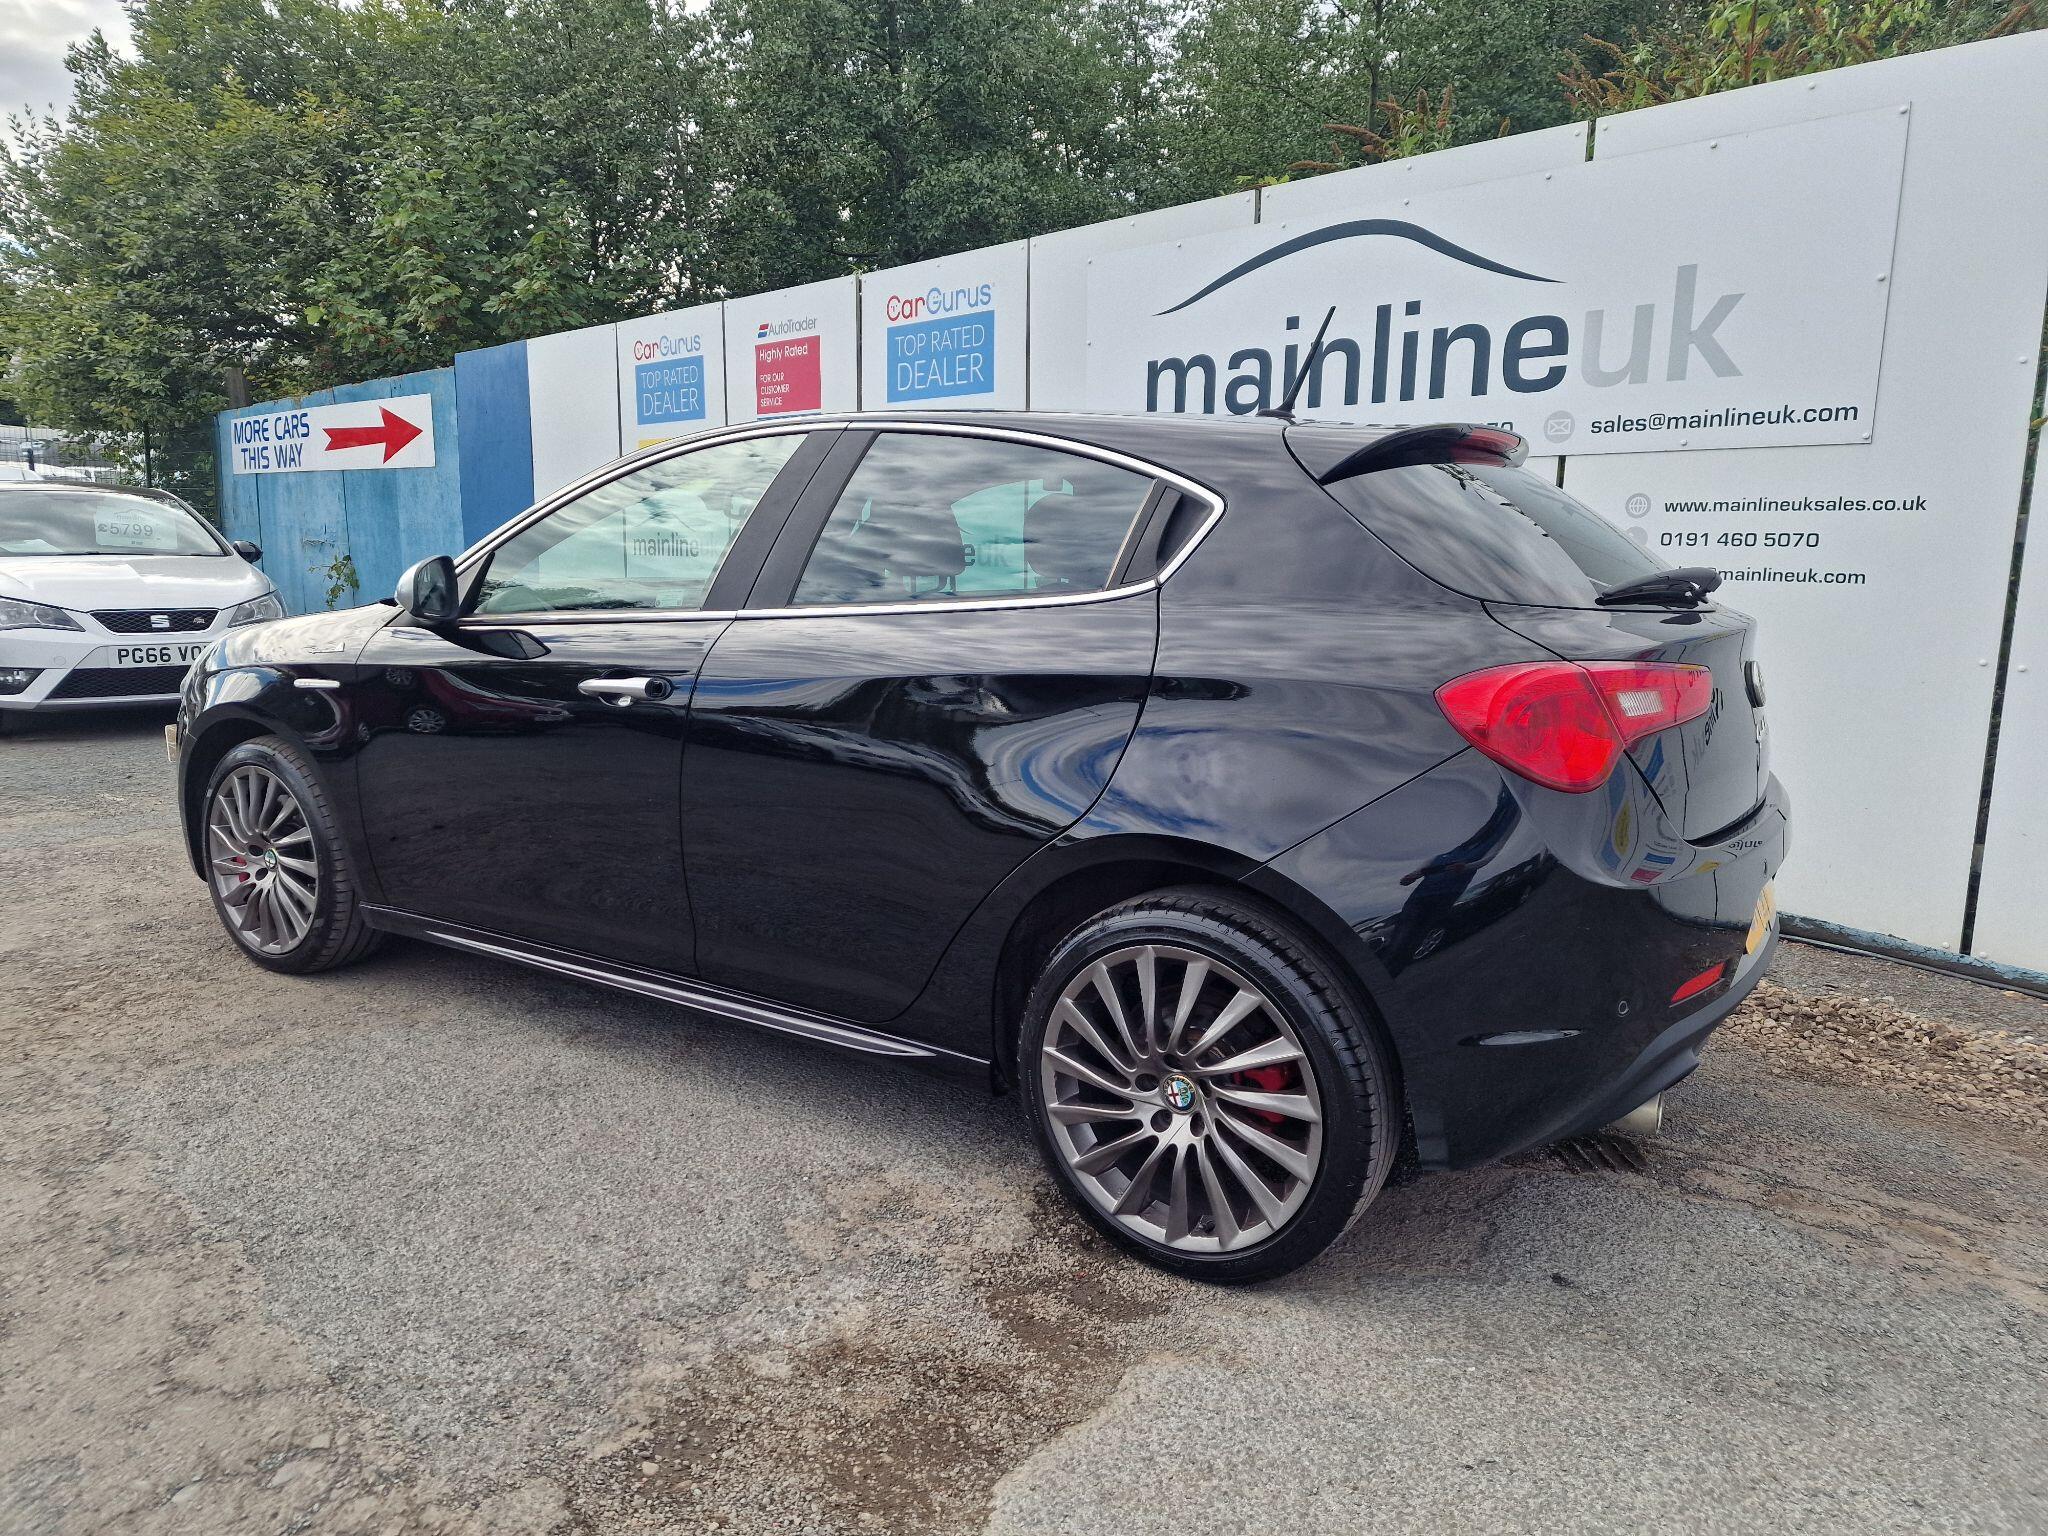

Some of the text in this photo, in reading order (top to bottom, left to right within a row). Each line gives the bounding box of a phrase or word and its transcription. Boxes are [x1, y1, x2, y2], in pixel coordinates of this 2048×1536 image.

[887, 284, 991, 321] CarGurus
[634, 335, 701, 360] CarGurus
[895, 325, 985, 356] TOP RATED
[1147, 264, 1745, 415] mainlineuk
[760, 343, 808, 362] Highly Rated
[641, 366, 698, 388] TOP RATED
[760, 372, 784, 383] FOR OUR
[898, 353, 984, 391] DEALER
[761, 384, 789, 395] CUSTOMER
[643, 388, 699, 415] DEALER
[760, 397, 782, 407] SERVICE
[234, 413, 310, 444] MORE CARS
[1591, 405, 1858, 434] sales@mainlineuk.com
[241, 443, 303, 470] THIS WAY
[1664, 496, 1927, 513] www.mainlineuksales.co.uk
[97, 522, 153, 537] £5799
[1660, 532, 1820, 548] 0191 460 5070
[1710, 567, 1866, 585] mainlineuk.com
[117, 645, 206, 664] PG66 VO
